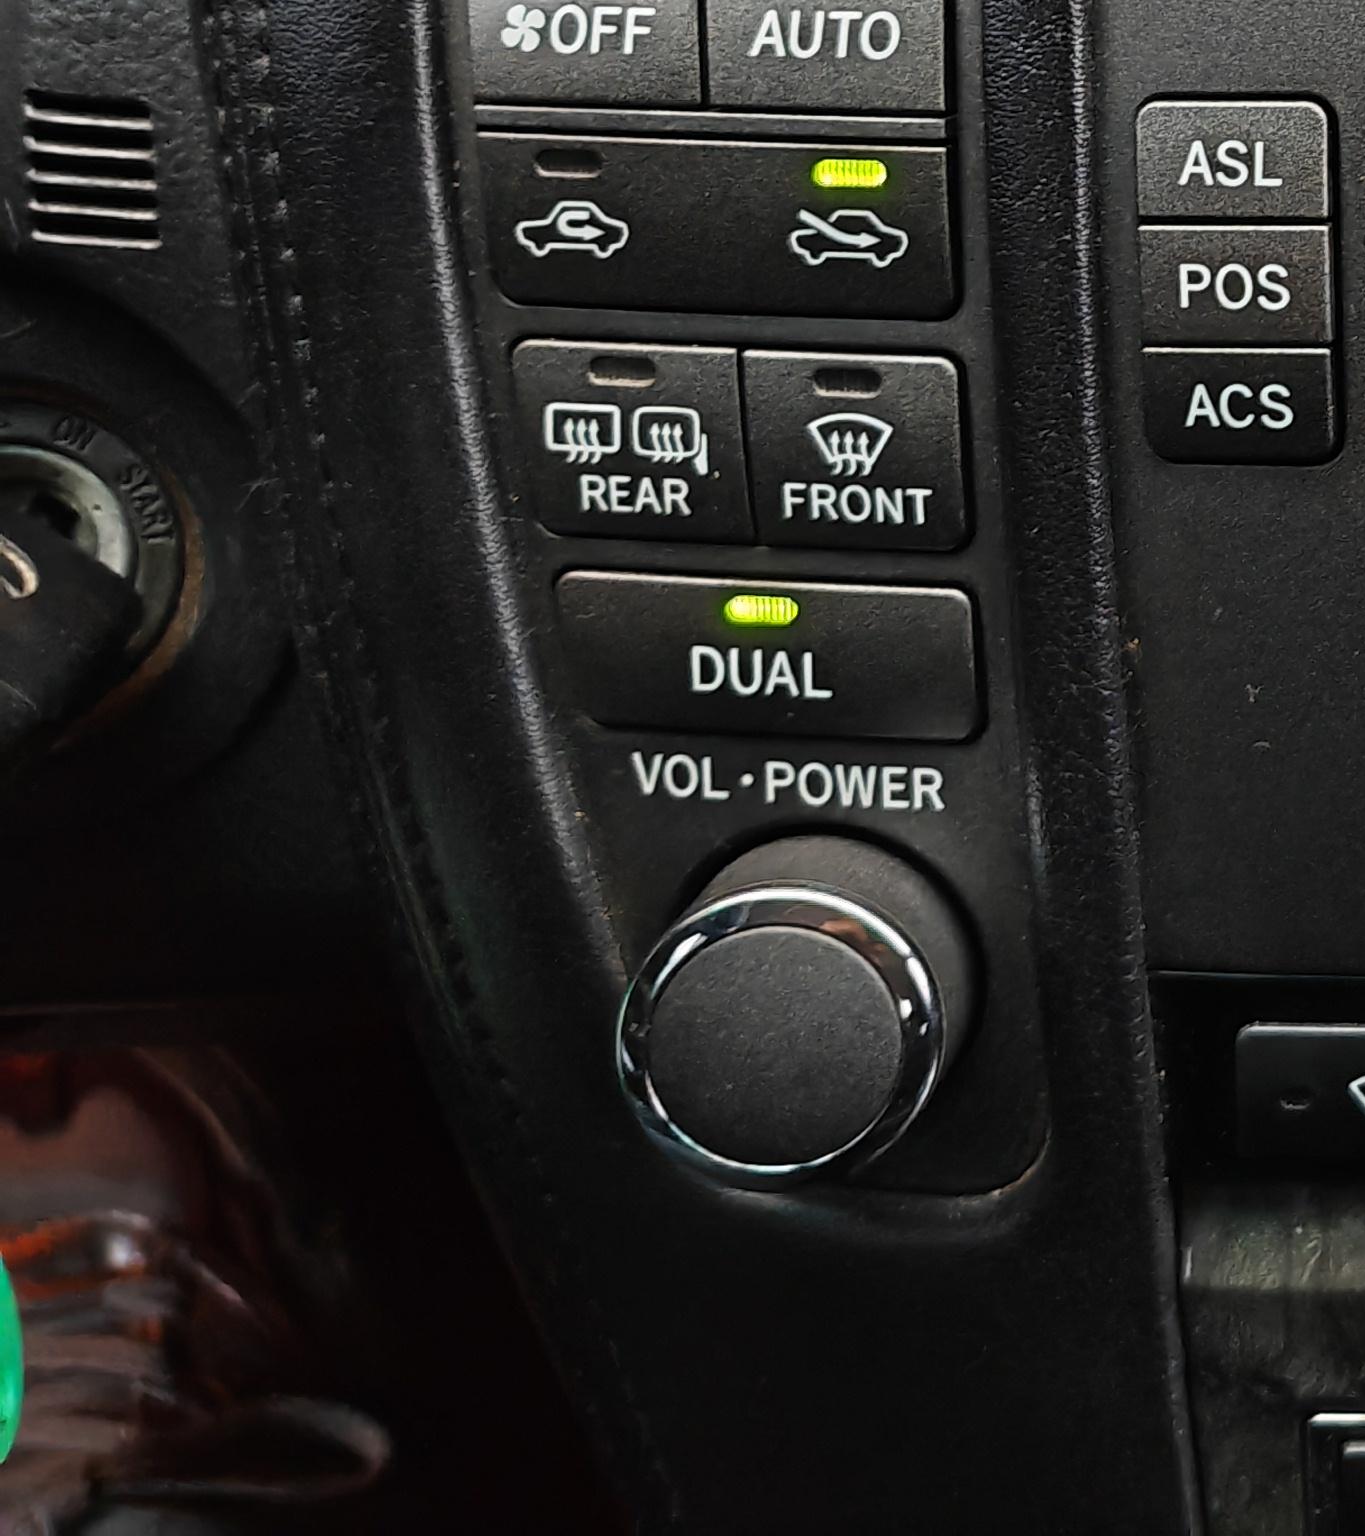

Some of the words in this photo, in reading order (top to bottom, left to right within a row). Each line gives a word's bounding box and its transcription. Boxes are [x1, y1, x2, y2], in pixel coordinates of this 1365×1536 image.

[549, 3, 658, 56] OFF
[747, 9, 901, 61] AUTO
[1177, 140, 1284, 190] ASL
[1177, 262, 1293, 312] POS
[1184, 383, 1295, 431] ACS
[579, 474, 693, 517] REAR
[781, 482, 934, 526] FRONT
[689, 644, 834, 699] DUAL
